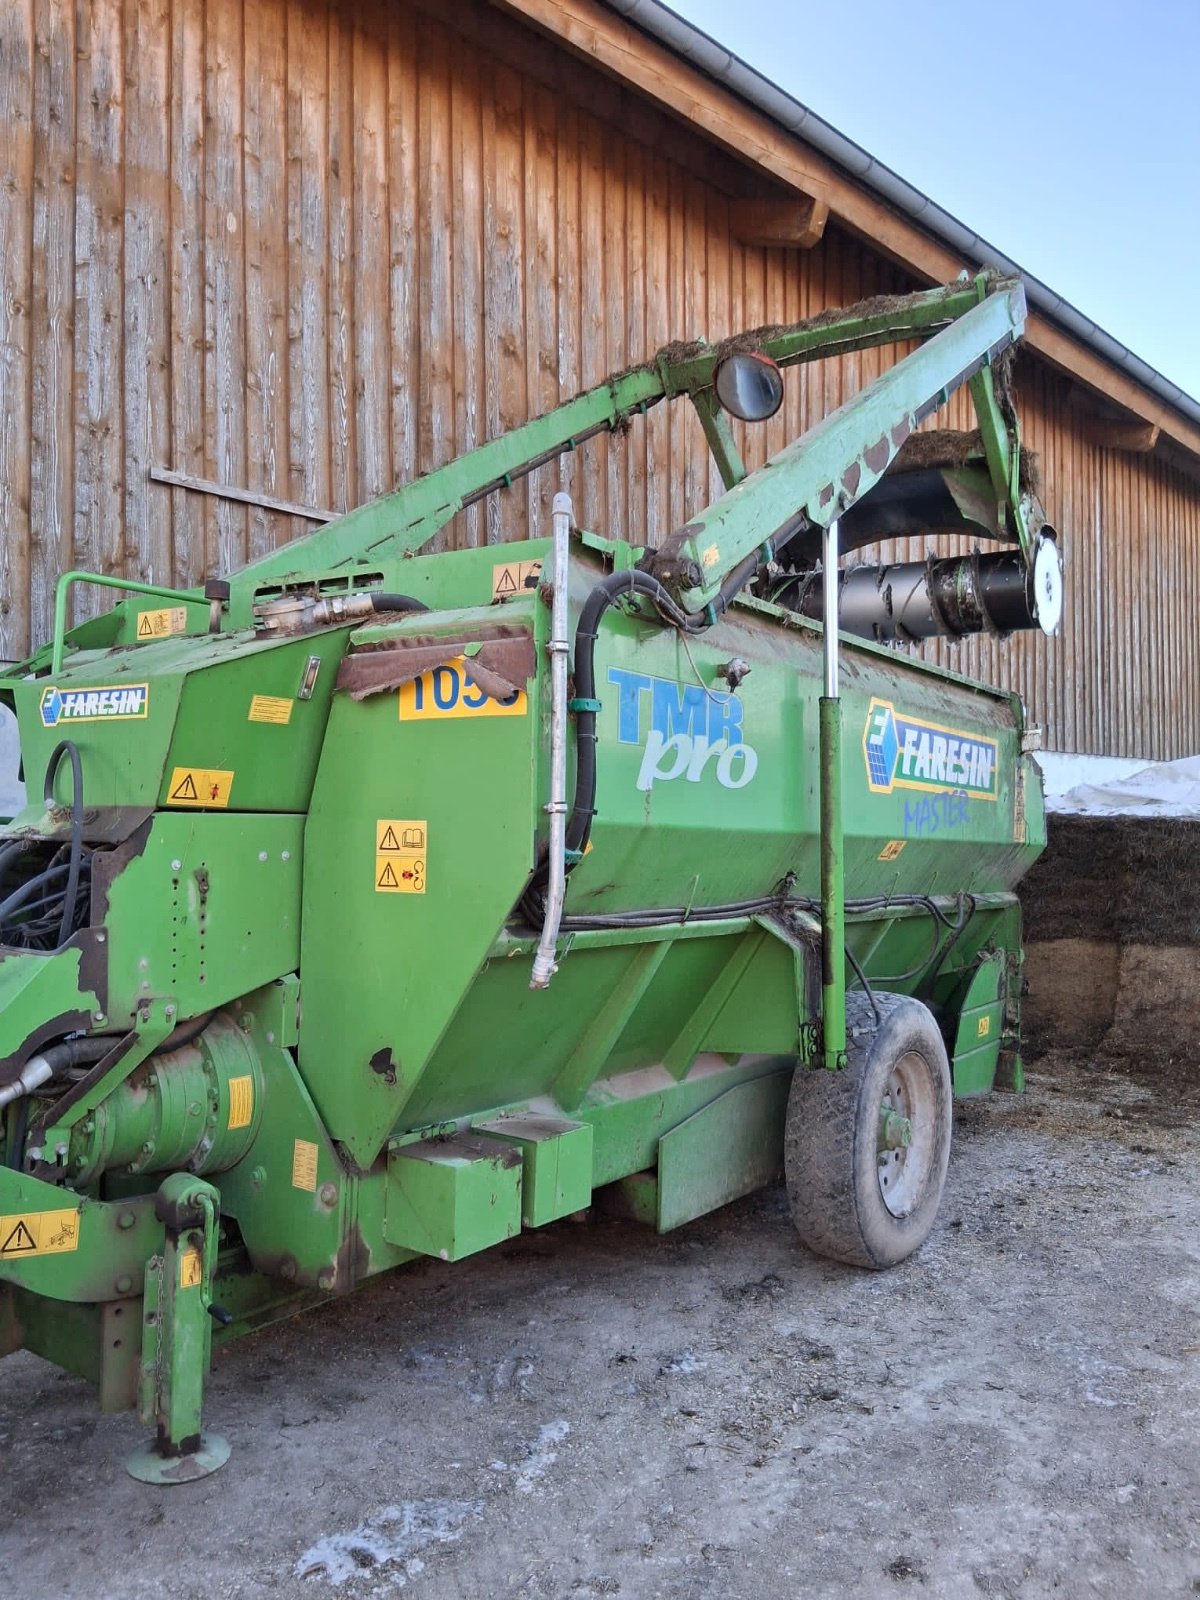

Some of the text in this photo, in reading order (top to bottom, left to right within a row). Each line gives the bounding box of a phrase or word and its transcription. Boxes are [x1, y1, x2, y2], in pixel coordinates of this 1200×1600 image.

[64, 689, 142, 717] FARESIN
[608, 666, 744, 758] TMR
[636, 730, 758, 791] pro
[902, 728, 993, 789] FARESIN
[904, 790, 971, 838] MASTER
